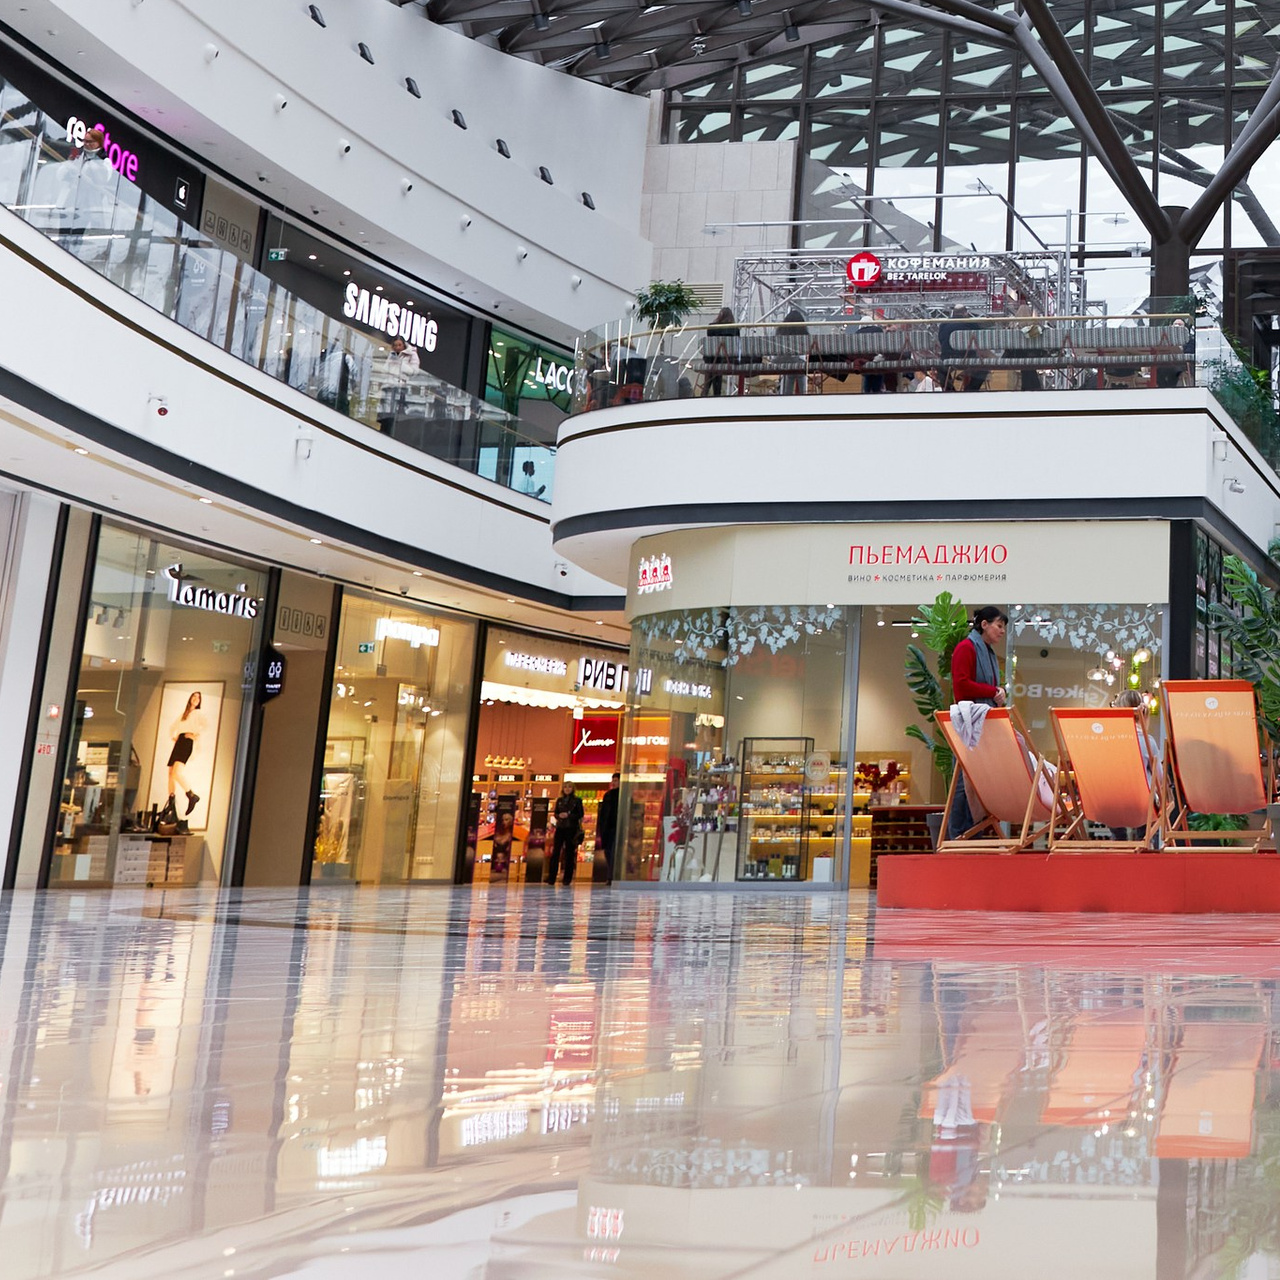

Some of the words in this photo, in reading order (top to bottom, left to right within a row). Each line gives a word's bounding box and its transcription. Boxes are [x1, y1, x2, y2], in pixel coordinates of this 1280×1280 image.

[887, 257, 990, 269] КОФЕМАНИЯ
[343, 282, 438, 352] SAMSUNG
[849, 544, 1008, 565] ПЬЕМАДЖИО
[160, 563, 259, 619] Tamaris
[945, 574, 1007, 582] ПАРФЮМЕРИЯ
[577, 657, 616, 690] РИВ
